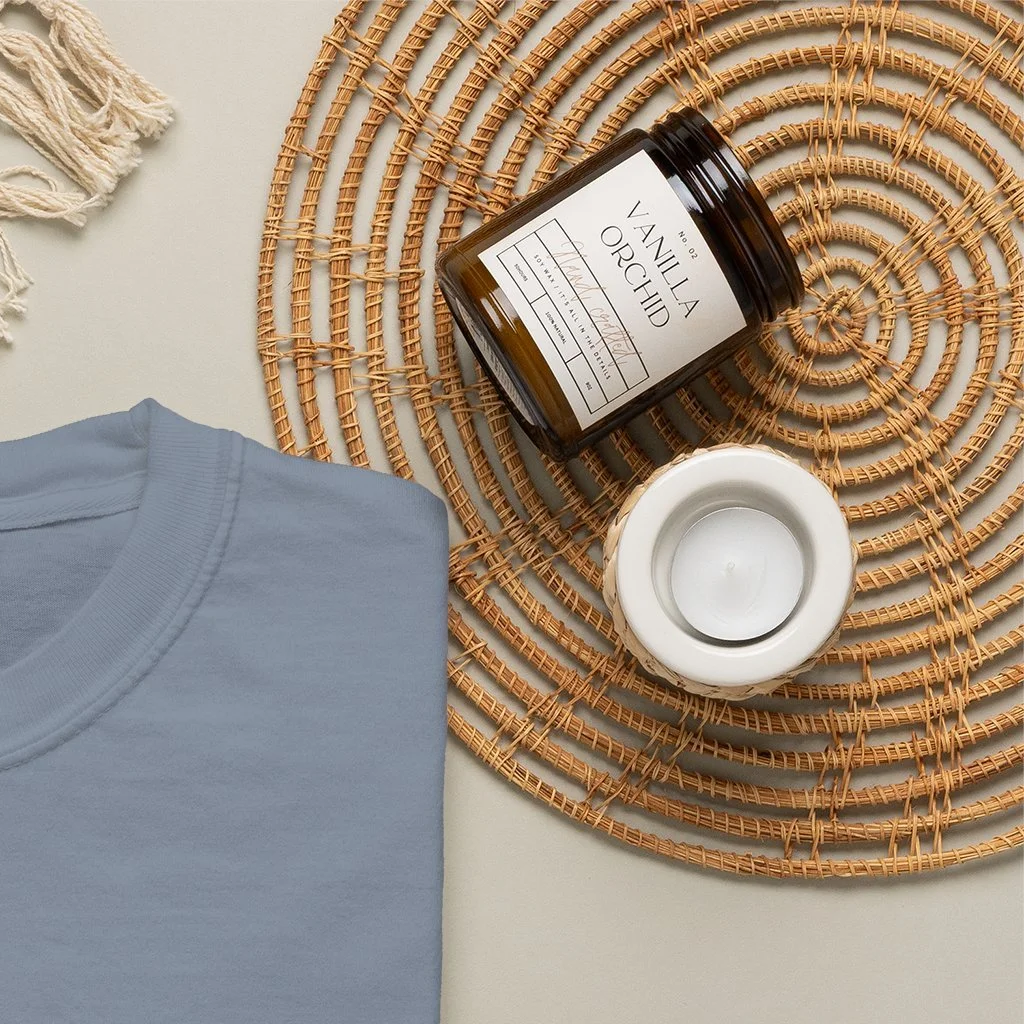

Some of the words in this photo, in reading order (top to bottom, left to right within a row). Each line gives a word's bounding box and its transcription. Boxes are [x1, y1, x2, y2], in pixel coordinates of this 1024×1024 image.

[600, 225, 670, 328] ORCHID
[626, 200, 700, 318] VANILLA
[678, 230, 689, 246] No.
[688, 248, 698, 260] 02
[534, 254, 544, 267] SOY
[544, 269, 555, 283] WAX
[558, 291, 569, 306] IT'S
[569, 309, 578, 322] ALL
[578, 324, 585, 334] IN
[585, 335, 595, 350] THE
[594, 351, 611, 380] DETAILS
[553, 324, 566, 345] NATURAL
